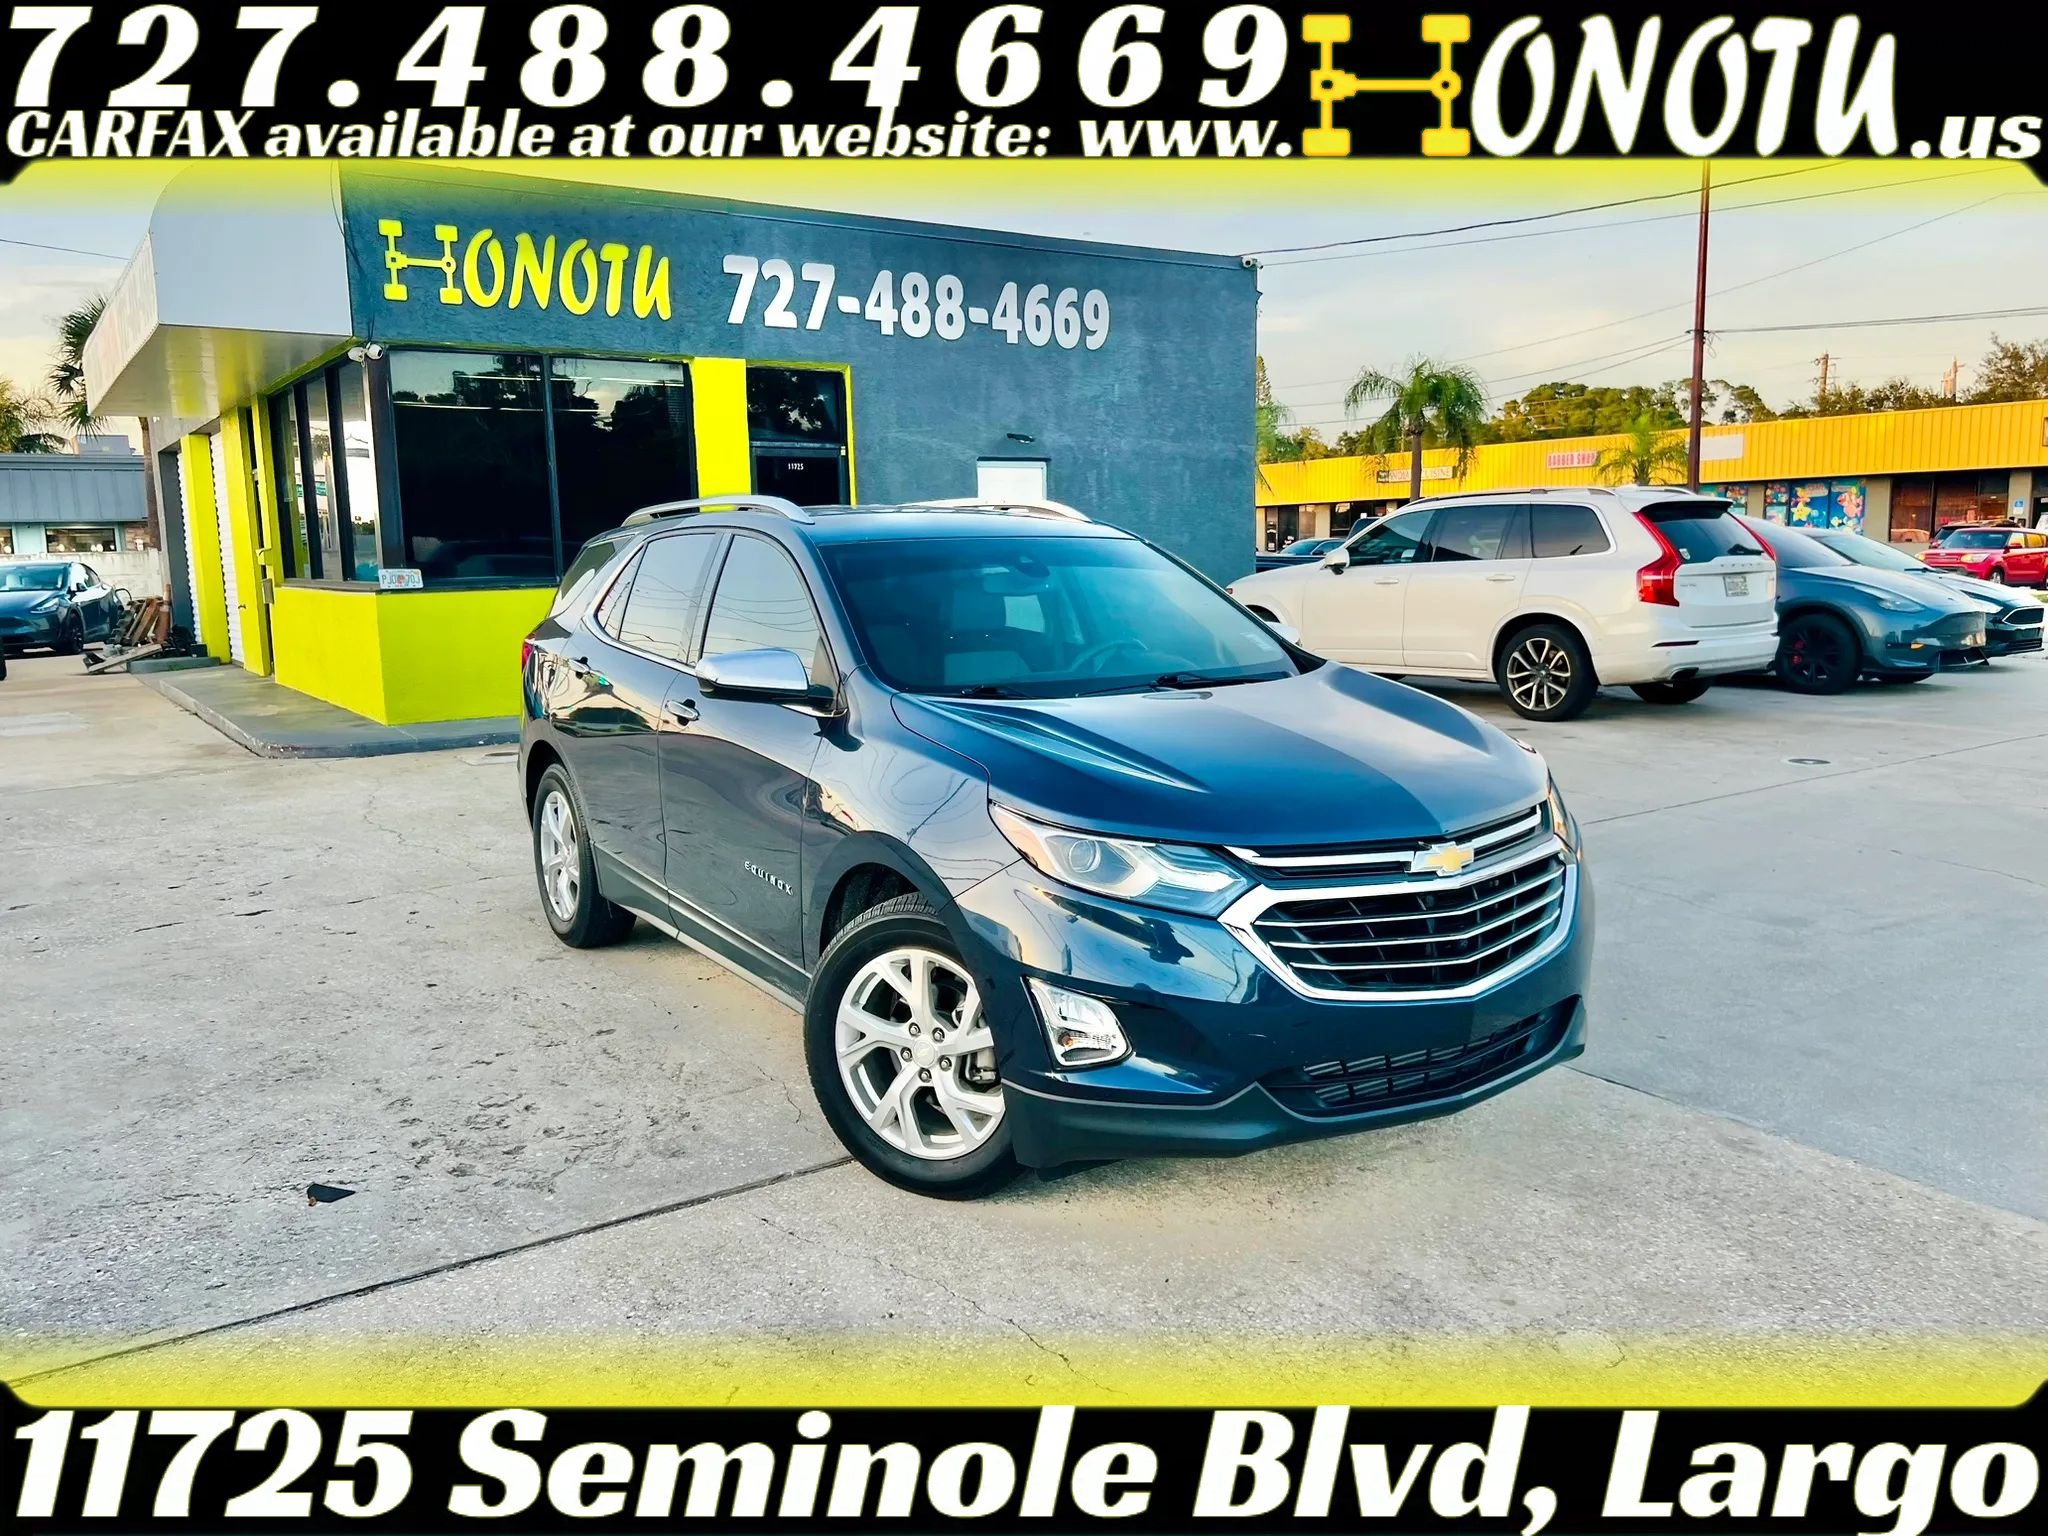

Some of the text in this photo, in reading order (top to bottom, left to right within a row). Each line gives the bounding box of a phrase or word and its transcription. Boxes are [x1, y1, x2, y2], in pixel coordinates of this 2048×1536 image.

[722, 254, 1110, 350] 727-488-4669
[787, 462, 804, 471] 11725
[744, 860, 793, 896] EQUINOX
